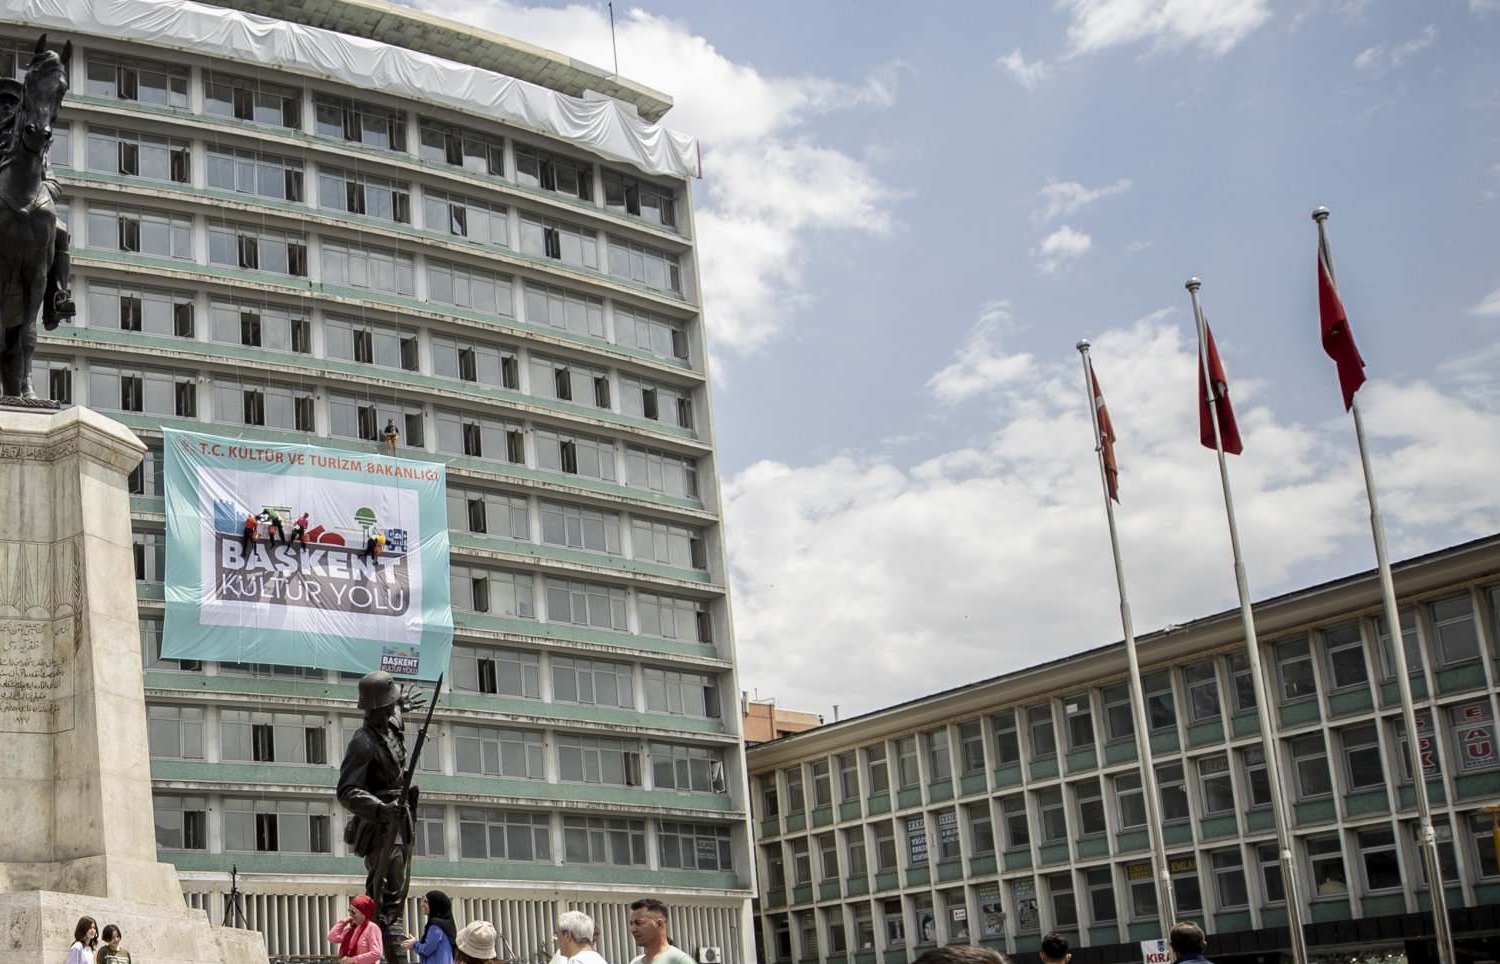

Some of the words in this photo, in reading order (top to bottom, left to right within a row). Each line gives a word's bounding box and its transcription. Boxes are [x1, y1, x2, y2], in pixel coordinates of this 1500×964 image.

[200, 442, 225, 457] T.C.
[228, 445, 284, 463] KÜLTÜR
[288, 453, 305, 465] VE
[309, 454, 362, 471] TURİZM
[366, 462, 440, 481] BAKANLIĞI
[222, 538, 400, 583] BAŞKENT
[222, 573, 321, 603] KÜLTÜR
[329, 582, 404, 611] YOLU
[382, 656, 418, 667] BAŞKENT
